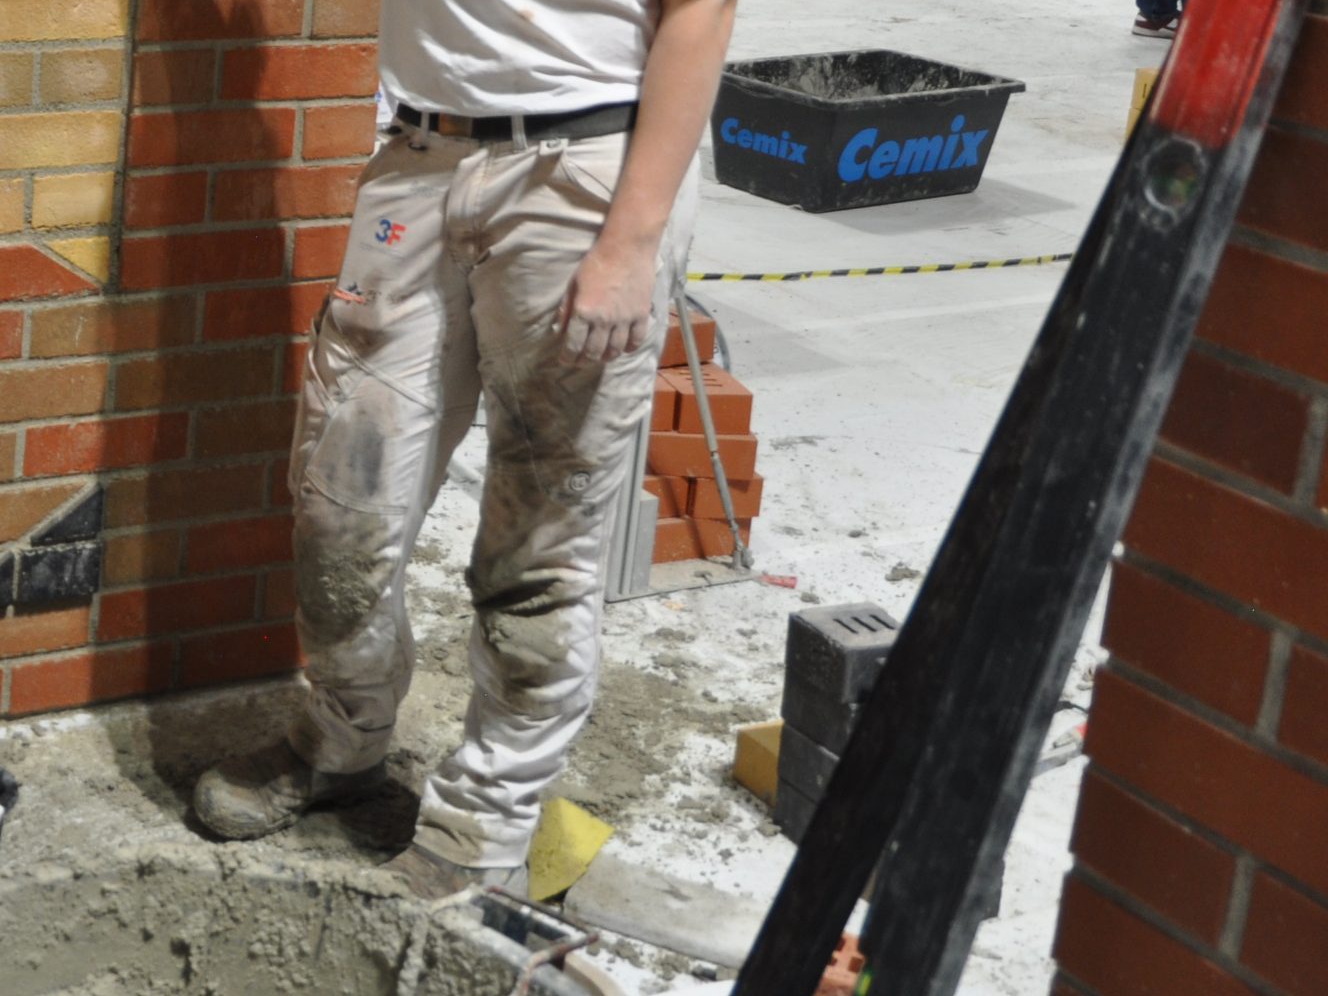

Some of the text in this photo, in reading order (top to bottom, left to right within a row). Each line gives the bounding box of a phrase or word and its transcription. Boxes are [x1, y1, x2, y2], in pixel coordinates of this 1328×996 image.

[721, 117, 808, 165] Cemix
[836, 114, 989, 184] Cemix
[375, 218, 407, 246] 3F
